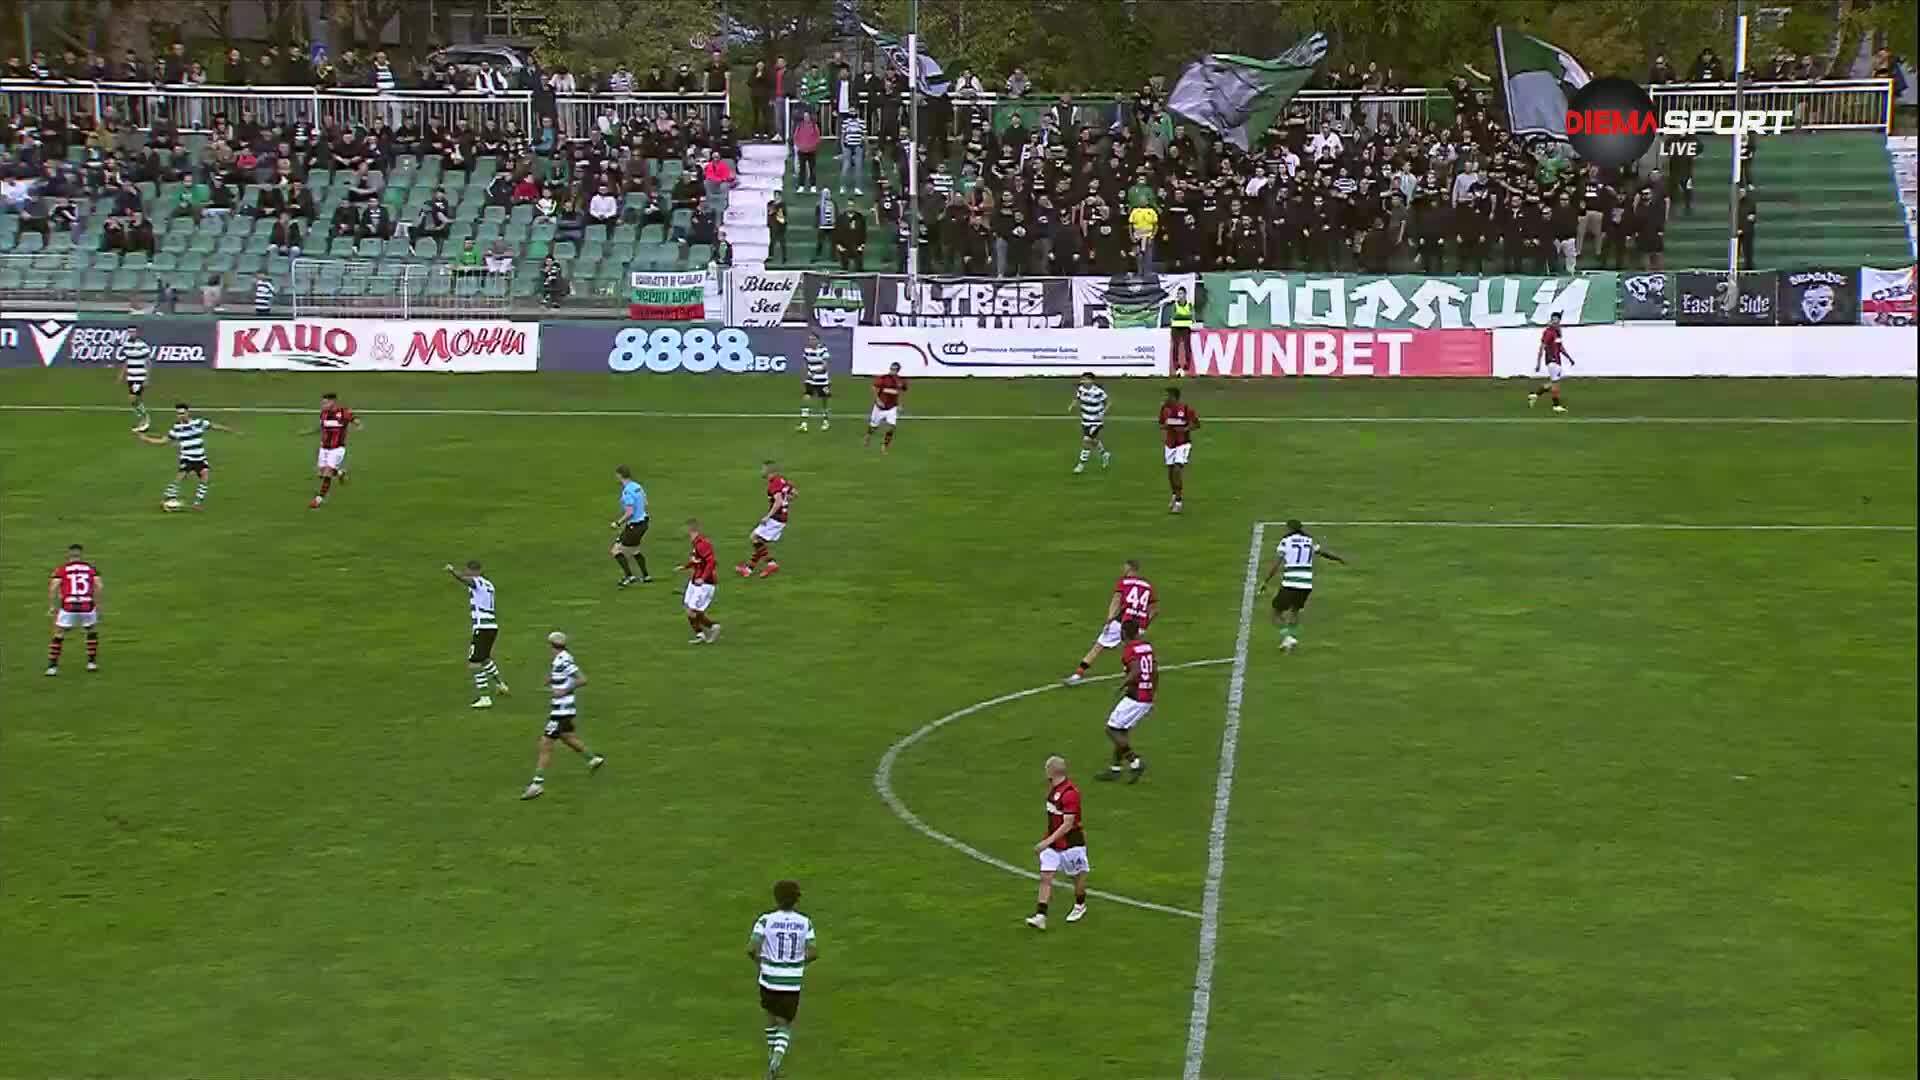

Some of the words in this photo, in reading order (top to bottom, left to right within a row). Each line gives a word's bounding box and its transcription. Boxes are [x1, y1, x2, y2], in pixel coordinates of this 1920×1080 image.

[740, 276, 793, 291] Black
[750, 298, 782, 313] Sea
[896, 282, 1043, 315] ULTRAS
[1682, 293, 1715, 313] East
[1739, 293, 1769, 313] Side
[72, 345, 113, 361] YOUR
[1190, 331, 1412, 376] WINBET
[1292, 544, 1313, 564] 77
[67, 574, 89, 595] 13
[1126, 587, 1150, 610] 44
[776, 932, 798, 960] 11
